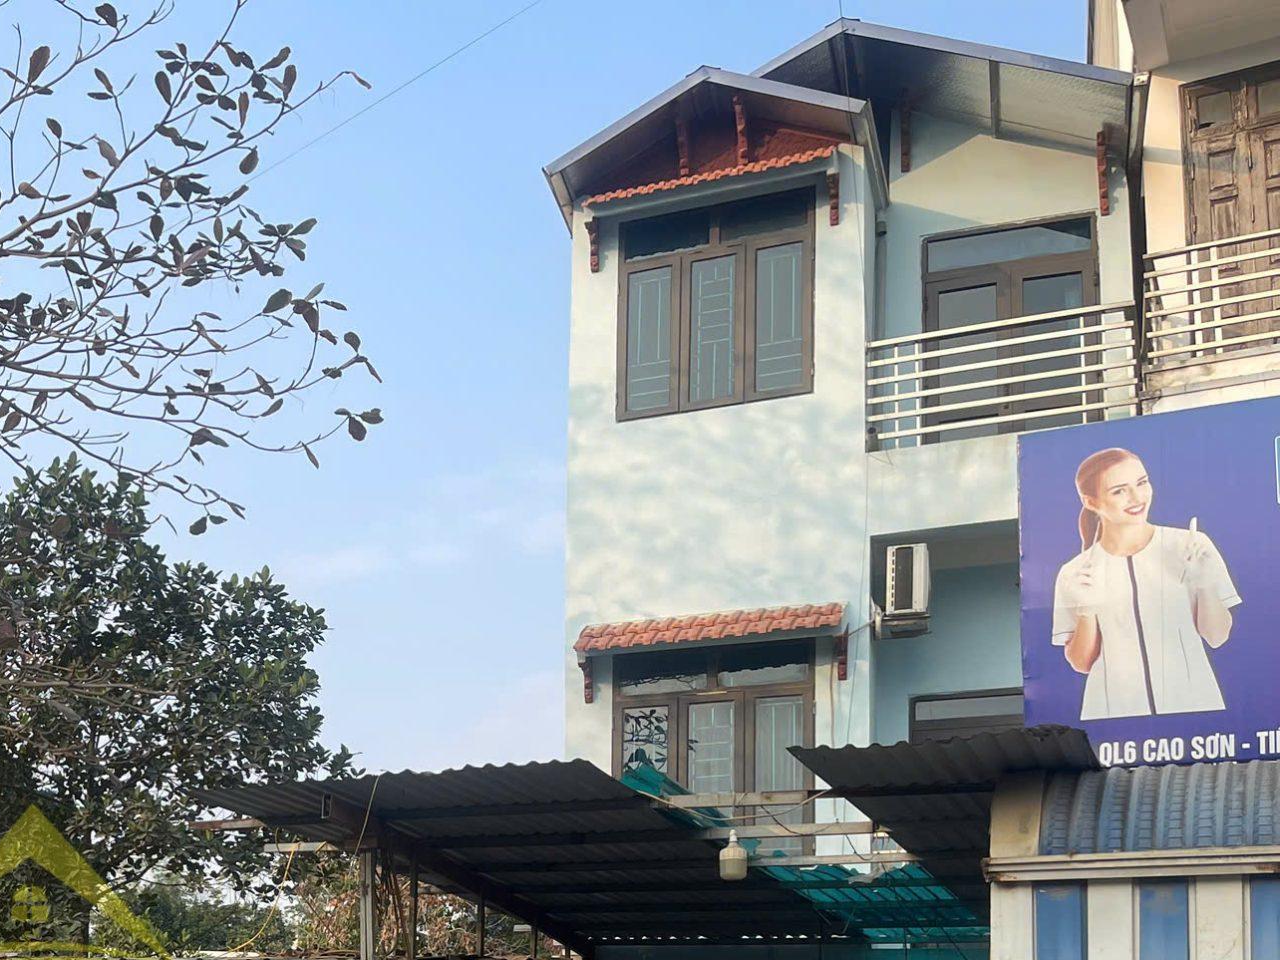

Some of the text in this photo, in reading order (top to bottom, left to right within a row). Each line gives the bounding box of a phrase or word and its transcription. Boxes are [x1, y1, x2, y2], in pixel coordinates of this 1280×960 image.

[1099, 741, 1137, 767] QL6
[1143, 737, 1184, 762] CAO
[1191, 732, 1235, 760] SƠN
